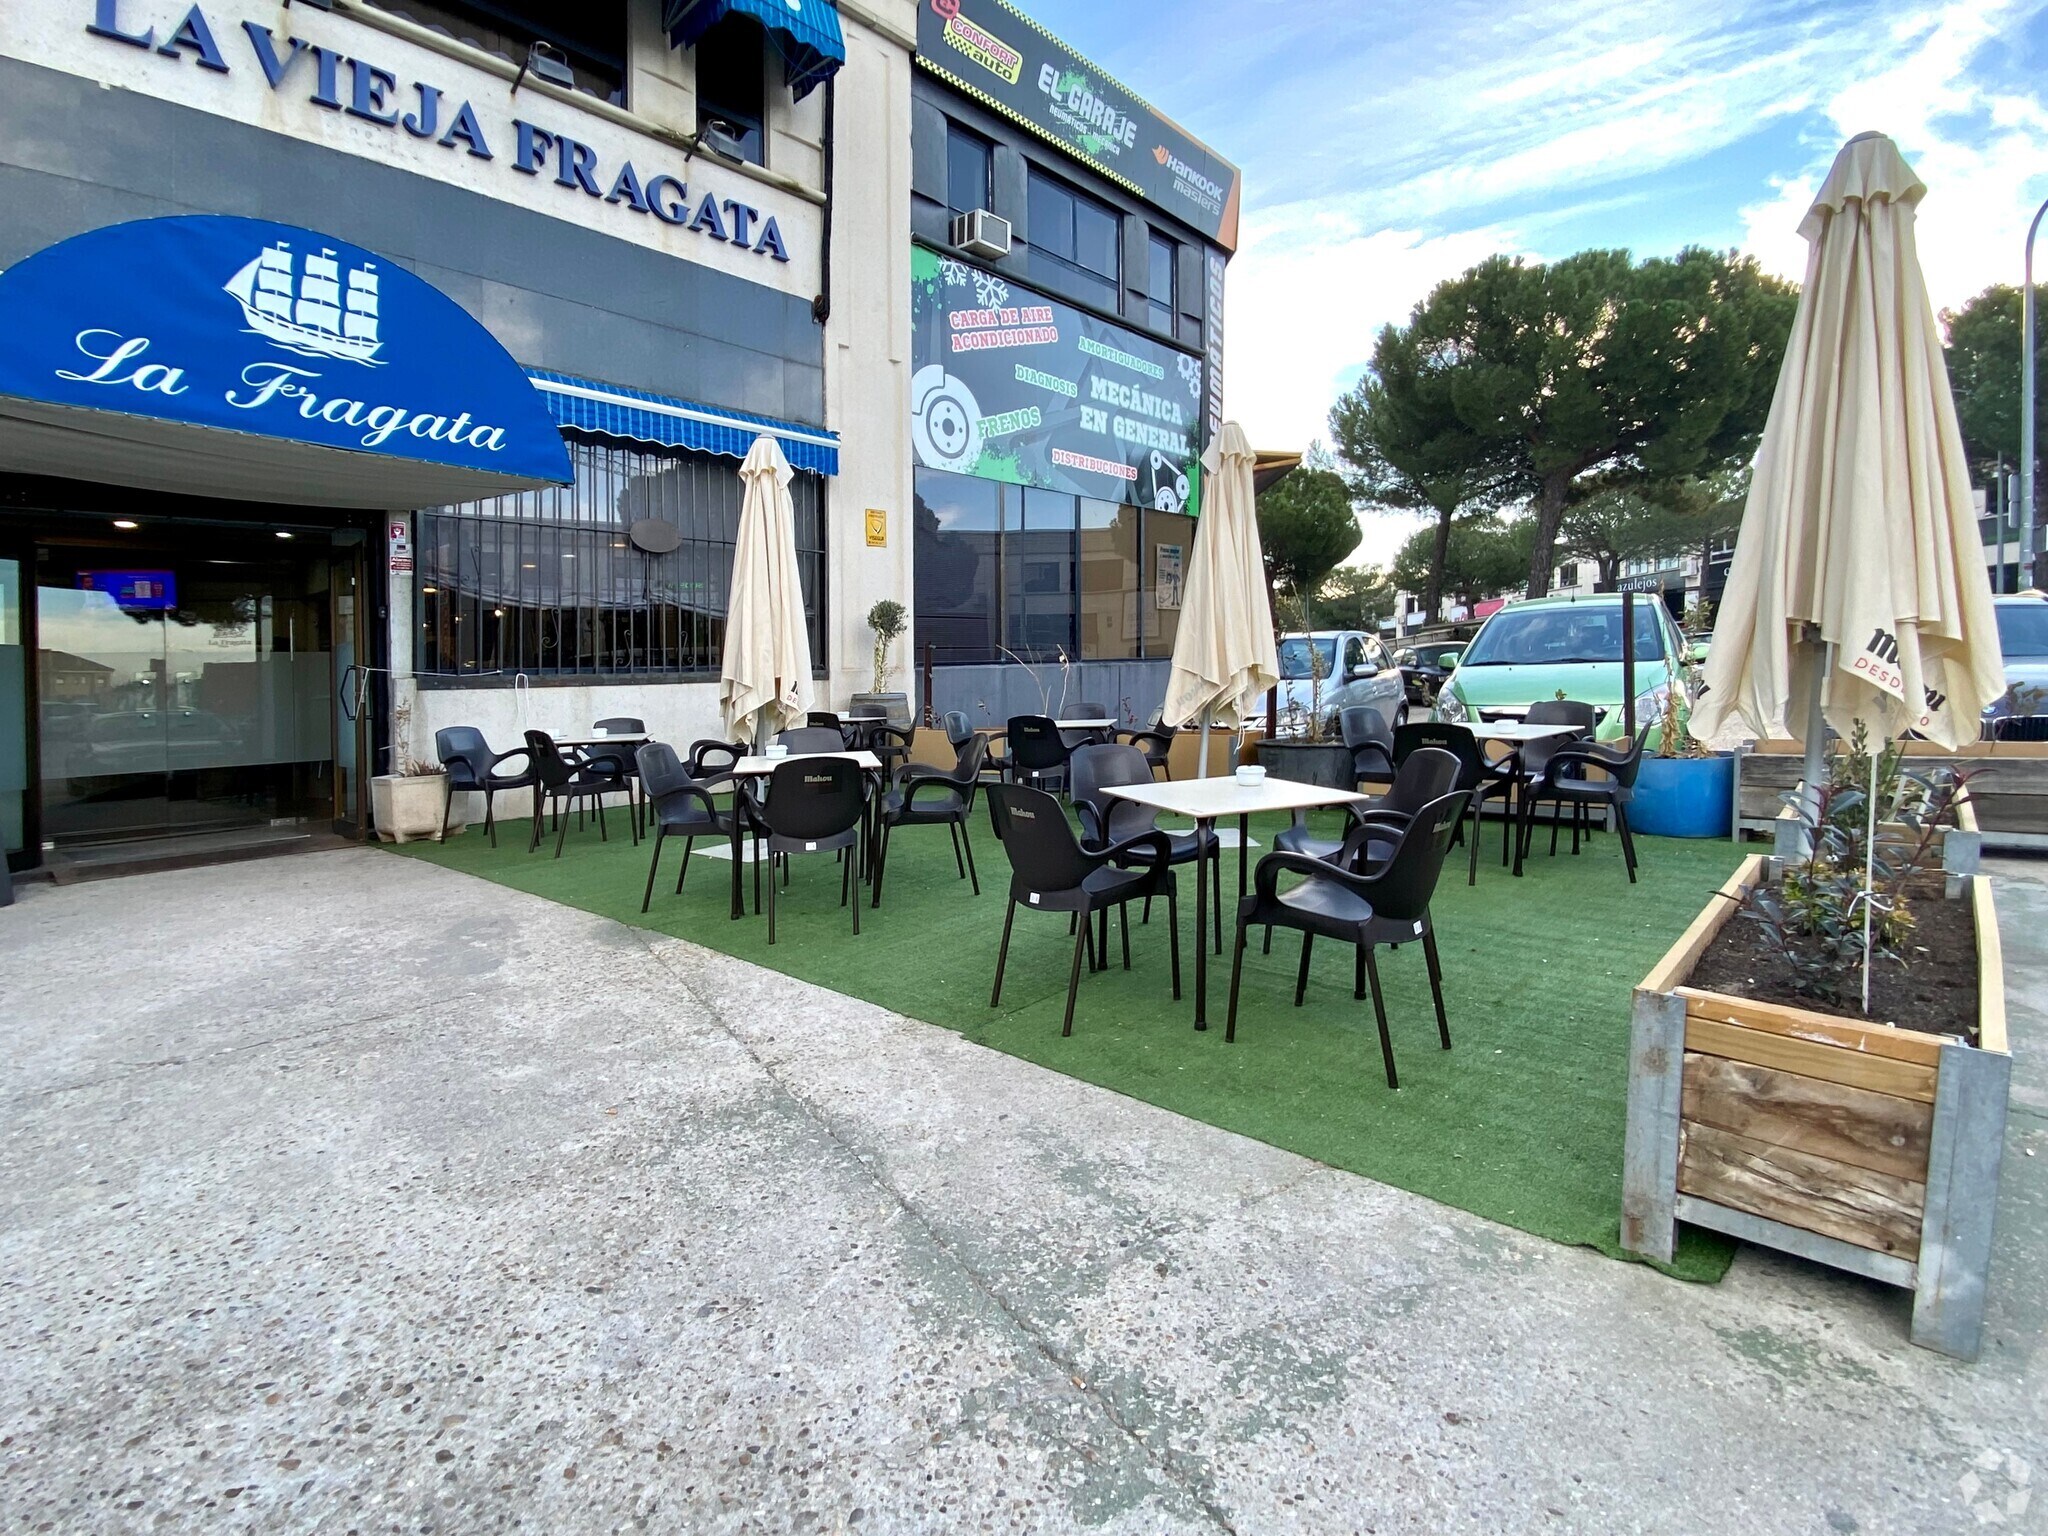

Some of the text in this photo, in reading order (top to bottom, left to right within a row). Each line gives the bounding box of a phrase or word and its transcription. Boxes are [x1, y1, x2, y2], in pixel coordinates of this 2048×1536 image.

[951, 18, 1019, 70] CONFORT
[972, 49, 1013, 80] auto
[1037, 62, 1138, 150] EL GARAJE
[85, 0, 791, 263] LA VIEJA FRAGATA
[1173, 178, 1221, 216] masters
[949, 306, 1053, 330] CARGA DE AIRE
[951, 326, 1058, 352] ACONDICIONADO
[1078, 336, 1164, 380] AMORTIGUADORES
[55, 328, 506, 447] La Fragata
[1015, 364, 1077, 398] DIAGNOSIS
[1091, 375, 1182, 427] MECÁNICA
[976, 406, 1041, 439] FRENOS
[1079, 404, 1190, 457] EN GENERAL
[1052, 448, 1137, 481] DISTRIBUCIONES
[1616, 577, 1657, 592] azulejos
[1854, 657, 1905, 695] DESD
